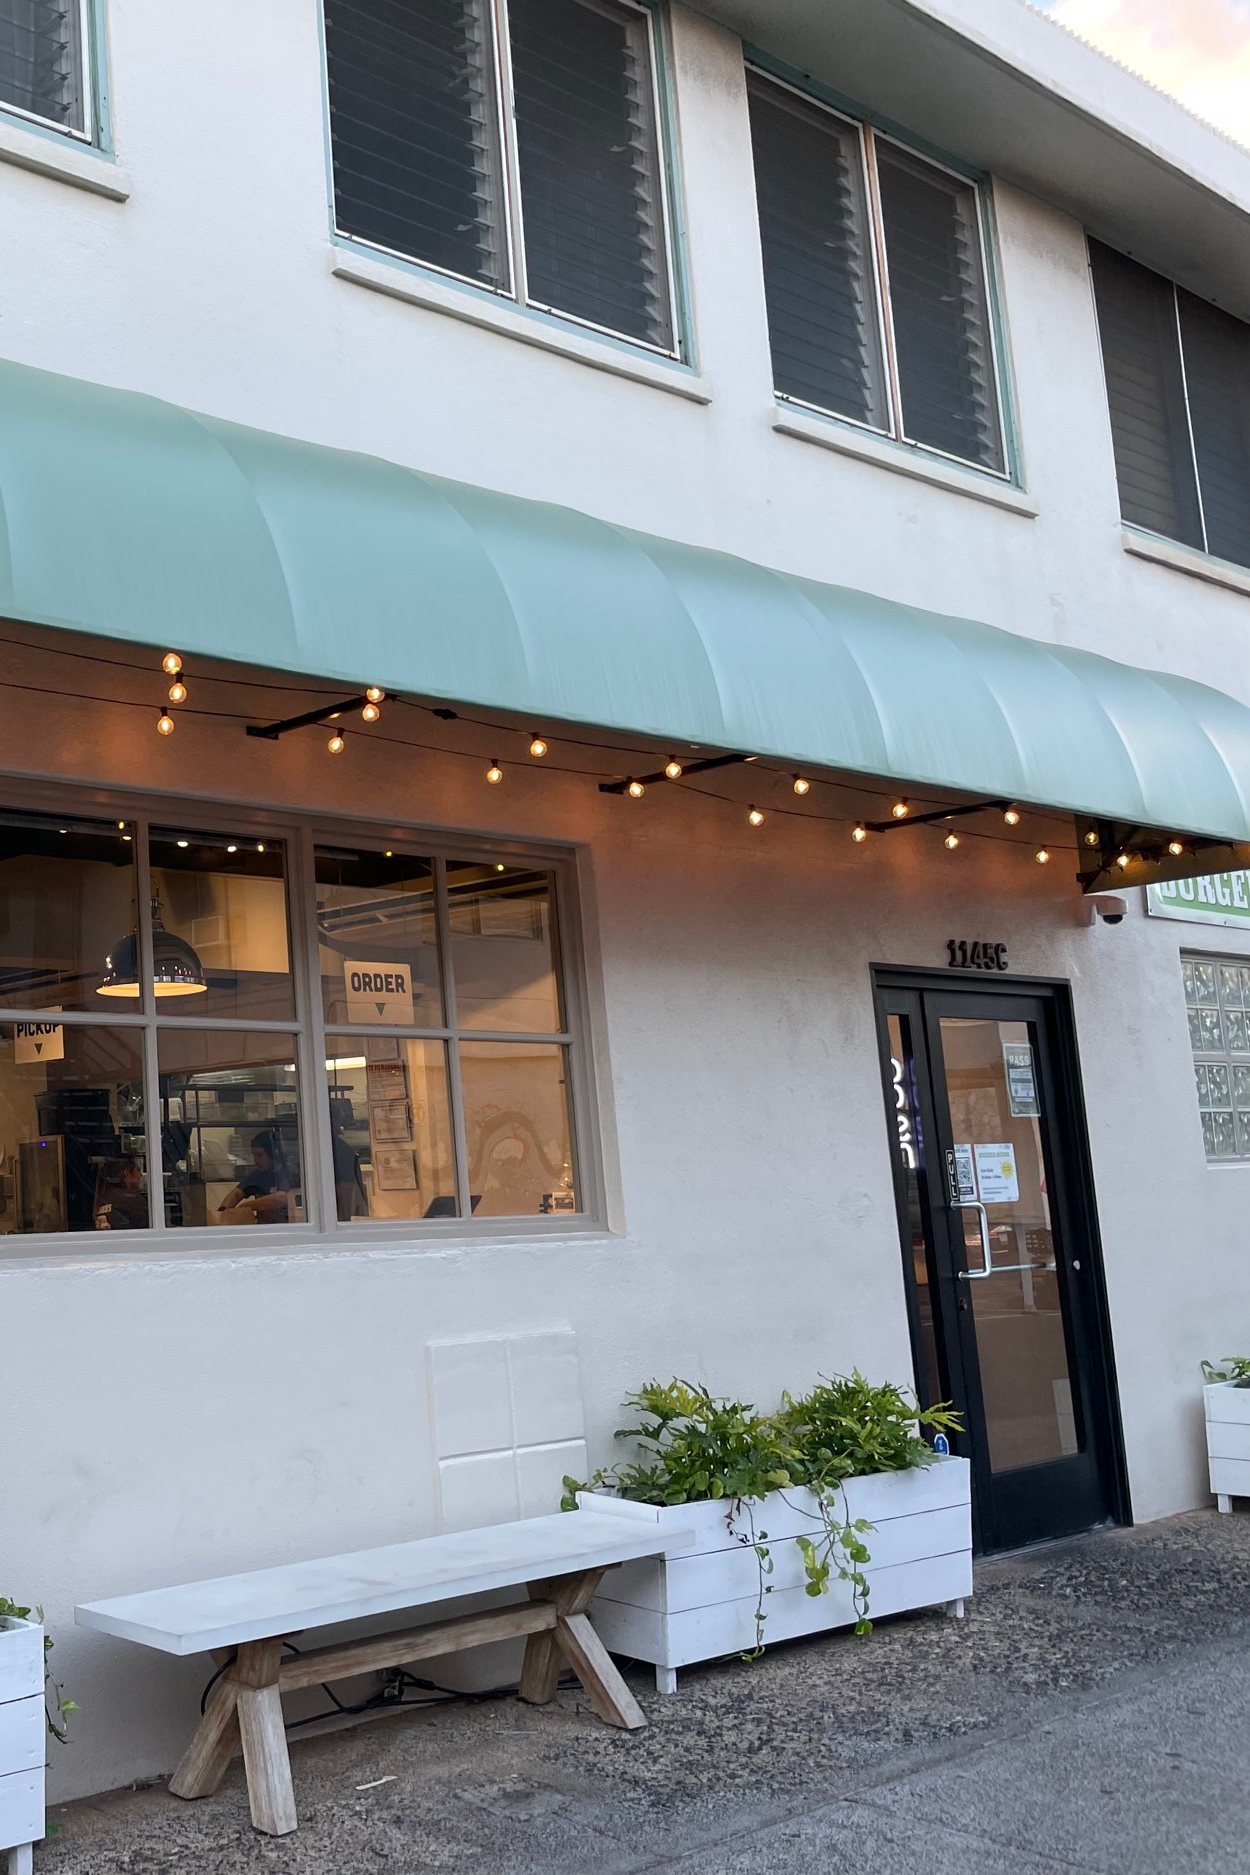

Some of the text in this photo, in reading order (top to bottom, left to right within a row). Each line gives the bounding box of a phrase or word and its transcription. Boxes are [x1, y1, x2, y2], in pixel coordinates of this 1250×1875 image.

[1161, 870, 1250, 909] URGE
[947, 939, 1008, 971] 1145C
[351, 972, 406, 993] ORDER
[1008, 1055, 1030, 1067] PASS
[947, 1153, 958, 1197] PULL
